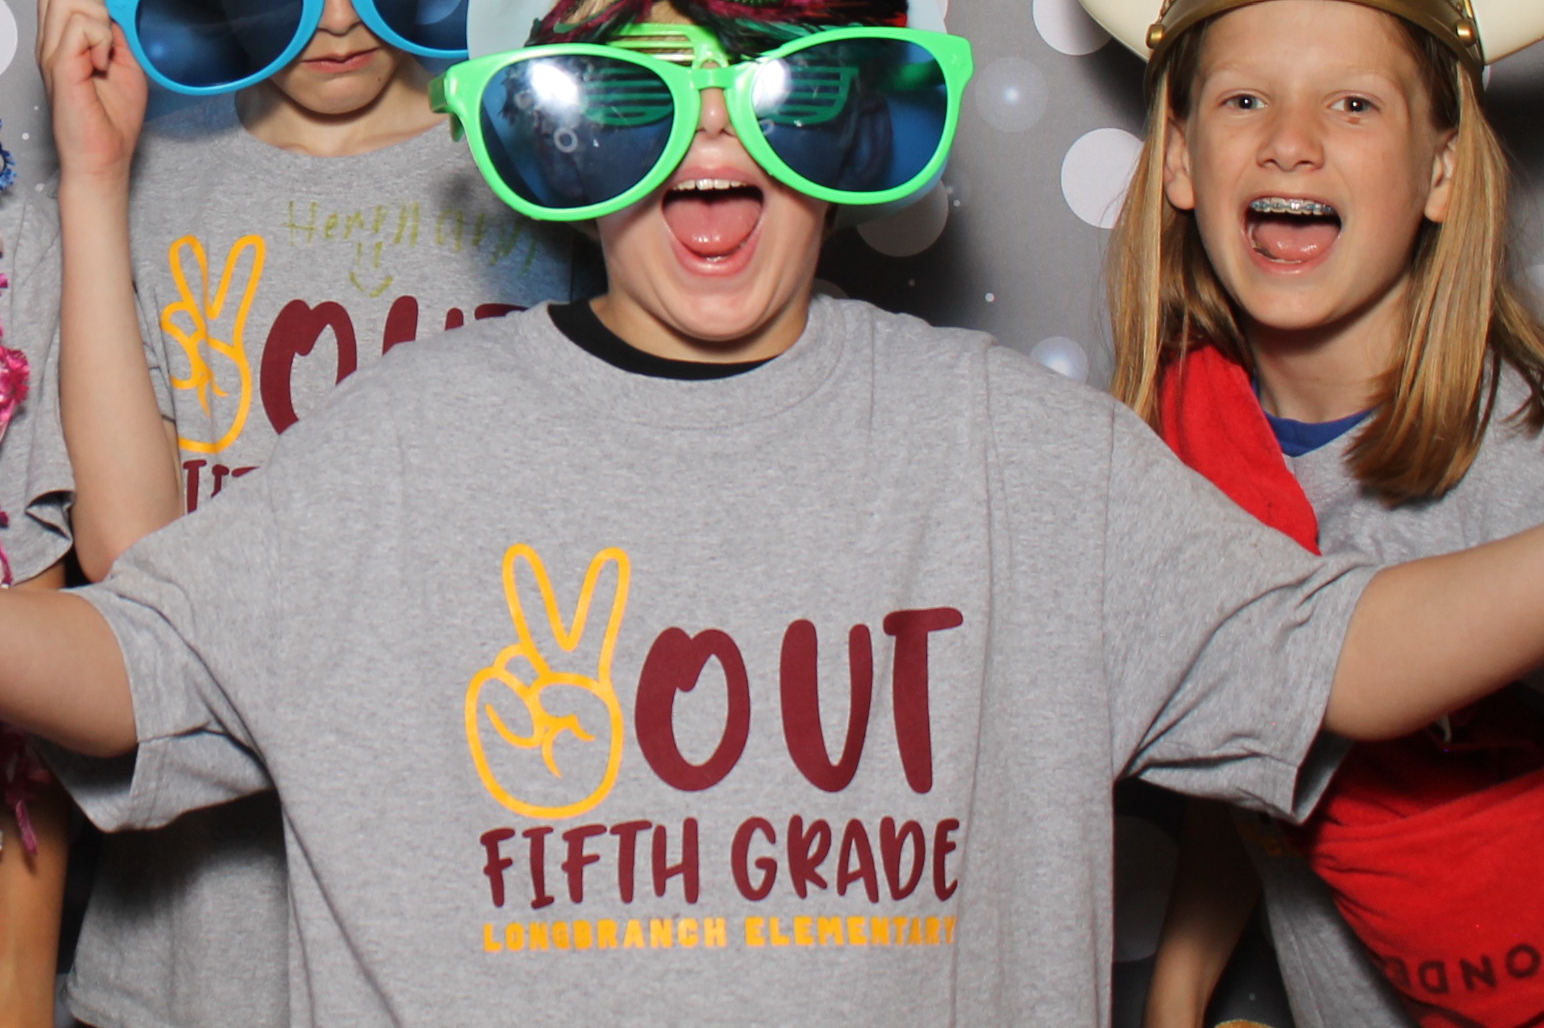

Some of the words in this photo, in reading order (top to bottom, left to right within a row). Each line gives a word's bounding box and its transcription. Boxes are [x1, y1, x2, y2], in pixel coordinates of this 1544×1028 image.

[634, 607, 963, 794] OUT
[480, 816, 699, 909] FIFTH
[730, 814, 960, 903] GRADE
[483, 917, 727, 953] LONGBRANCH
[744, 916, 956, 947] ELEMENTARY
